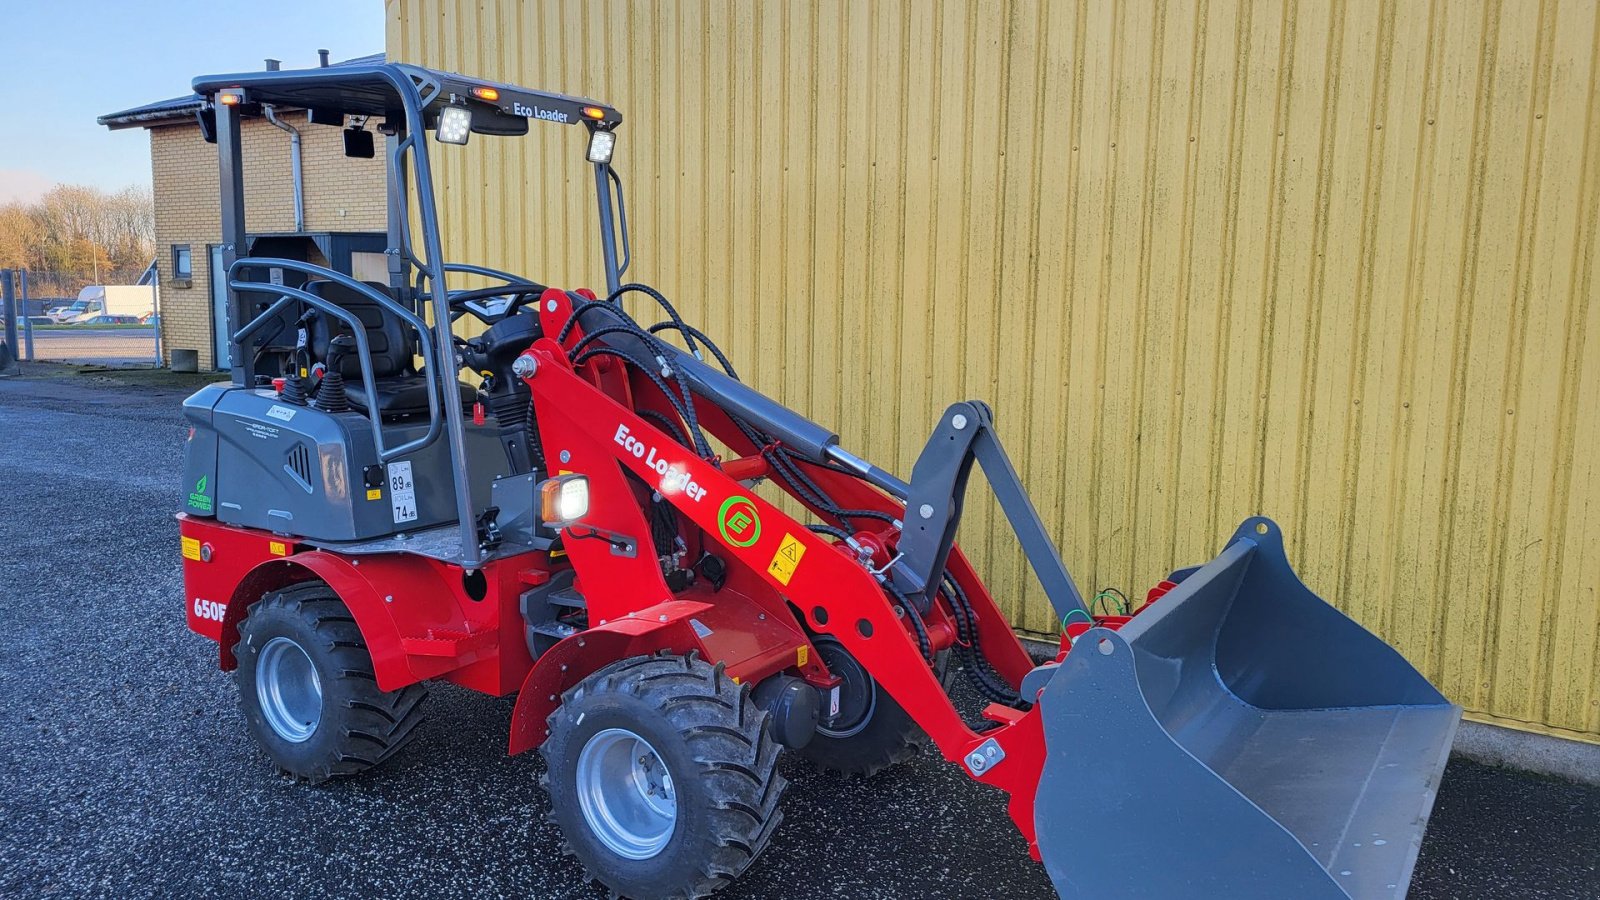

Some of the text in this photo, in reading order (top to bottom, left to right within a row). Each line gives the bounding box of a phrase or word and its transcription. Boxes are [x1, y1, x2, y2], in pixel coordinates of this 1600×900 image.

[513, 102, 568, 123] Eco Loader
[613, 424, 708, 503] Eco Loader
[392, 476, 404, 490] 89
[190, 492, 212, 503] GREEN
[188, 499, 212, 512] POWER
[395, 505, 408, 520] 74
